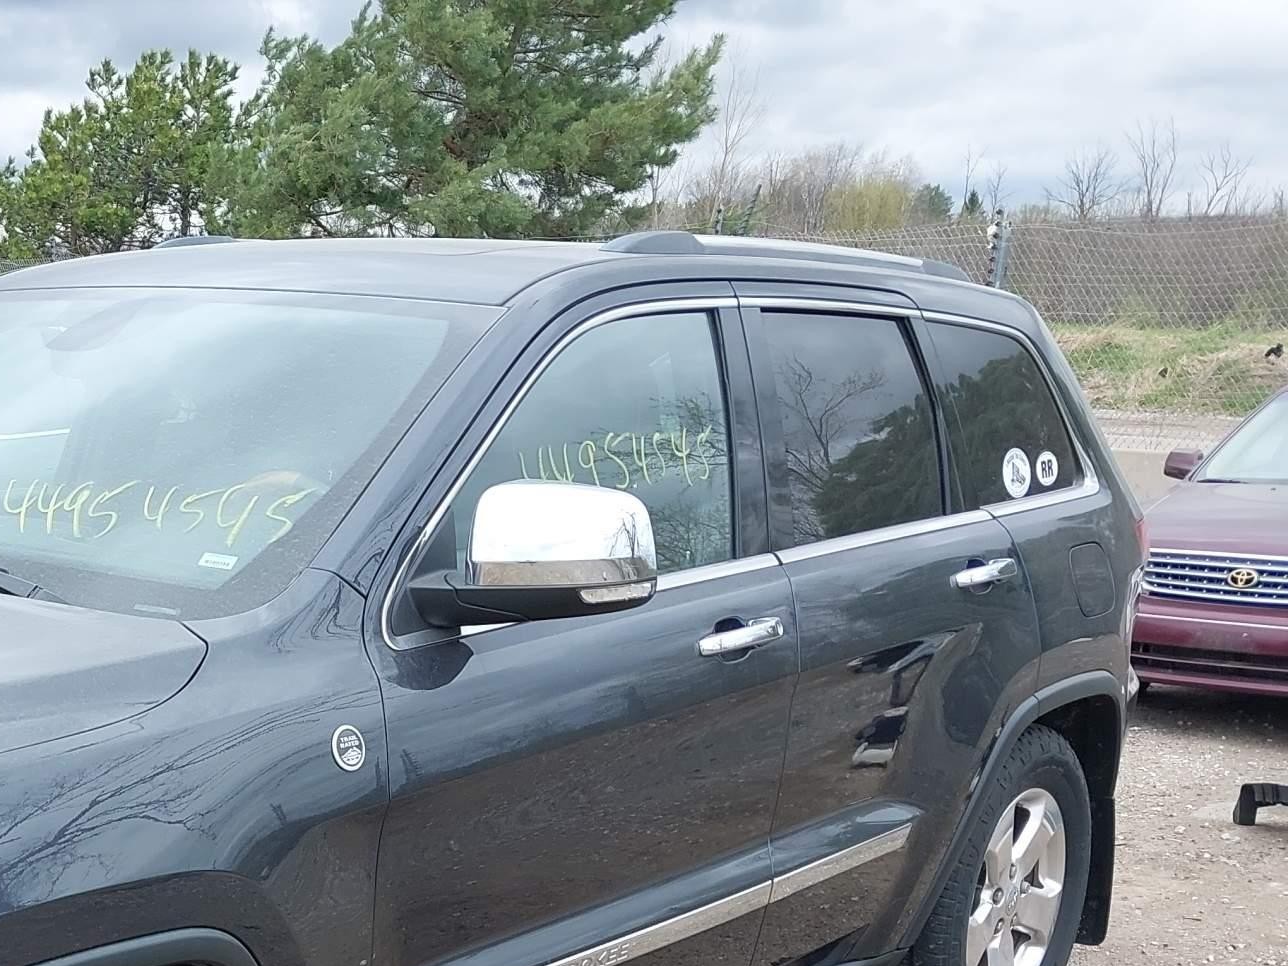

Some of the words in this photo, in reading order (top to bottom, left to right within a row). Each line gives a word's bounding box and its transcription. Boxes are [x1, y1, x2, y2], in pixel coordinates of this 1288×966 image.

[1040, 458, 1054, 479] RR
[339, 735, 359, 743] TRAIL
[339, 740, 360, 749] RATED
